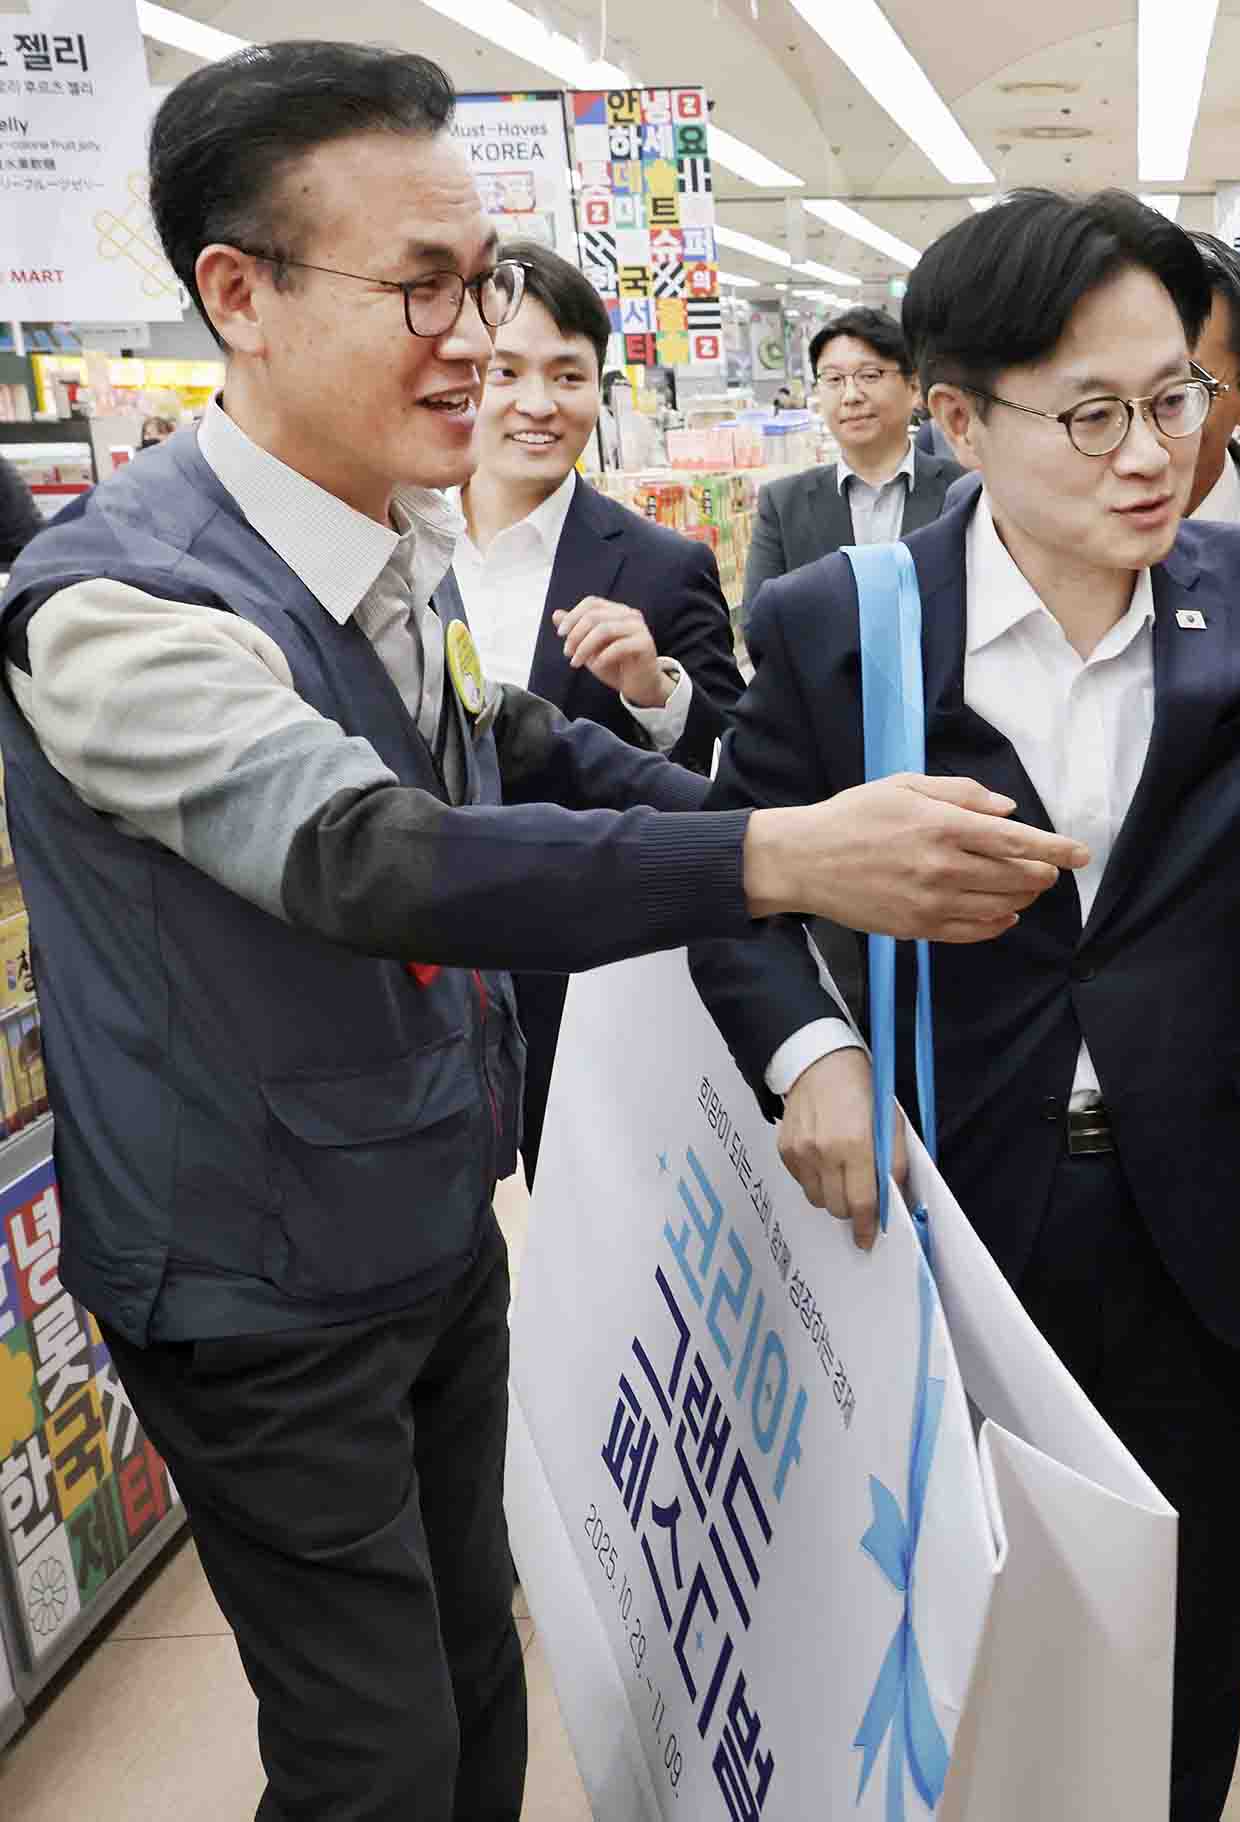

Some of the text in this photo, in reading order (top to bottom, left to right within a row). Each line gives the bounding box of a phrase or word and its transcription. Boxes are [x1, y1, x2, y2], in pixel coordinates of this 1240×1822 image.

[14, 33, 88, 72] 젤리
[471, 144, 545, 161] KOREA
[10, 269, 64, 285] MART
[663, 1145, 808, 1504] 코리아
[698, 1076, 732, 1150] 희망이
[728, 1131, 753, 1191] 되는
[789, 1268, 834, 1377] 성장하는
[832, 1359, 857, 1432] 경제
[600, 1373, 777, 1822] 페스티벌
[632, 1264, 773, 1633] 그랜드
[585, 1503, 682, 1799] 2025. 10. 29. 11. 09.
